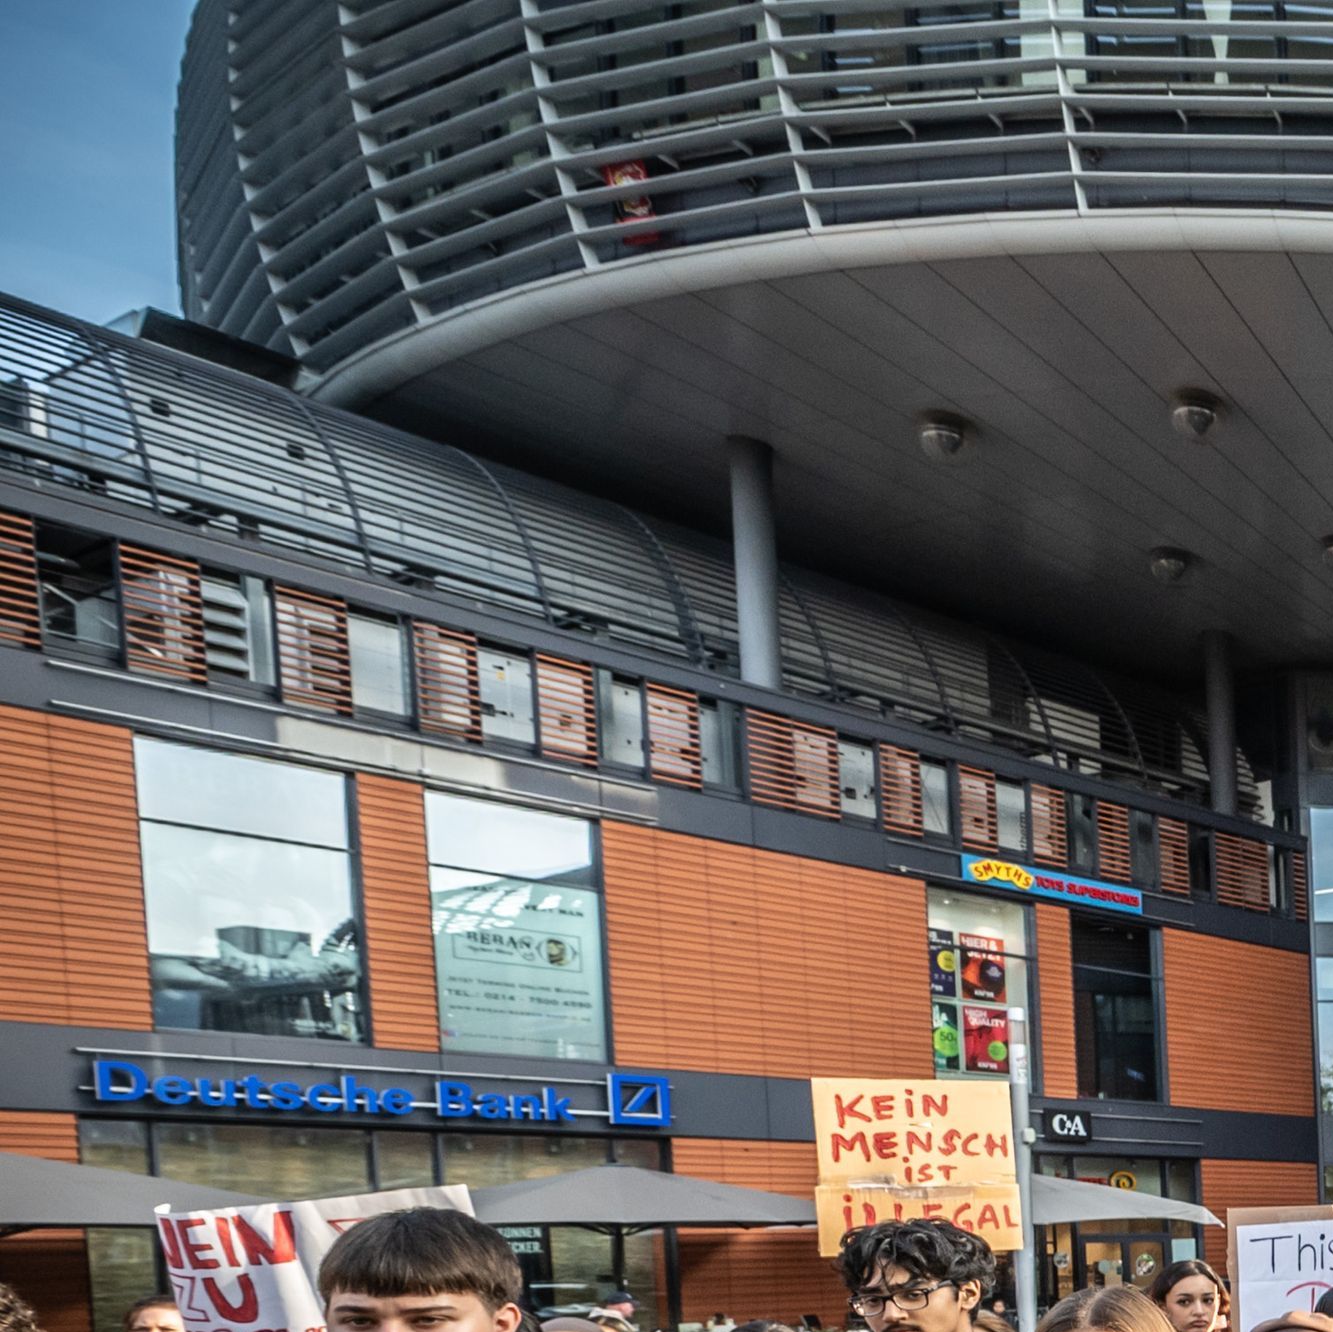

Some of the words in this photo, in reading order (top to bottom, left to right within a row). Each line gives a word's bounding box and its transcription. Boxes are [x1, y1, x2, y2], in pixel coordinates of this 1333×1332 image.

[973, 860, 1032, 888] SMYTHS
[94, 1060, 413, 1116] Deutsche
[435, 1081, 577, 1123] Bank
[1051, 1113, 1087, 1137] C&A
[830, 1128, 1009, 1163] MENSCH
[171, 1273, 259, 1324] ZU
